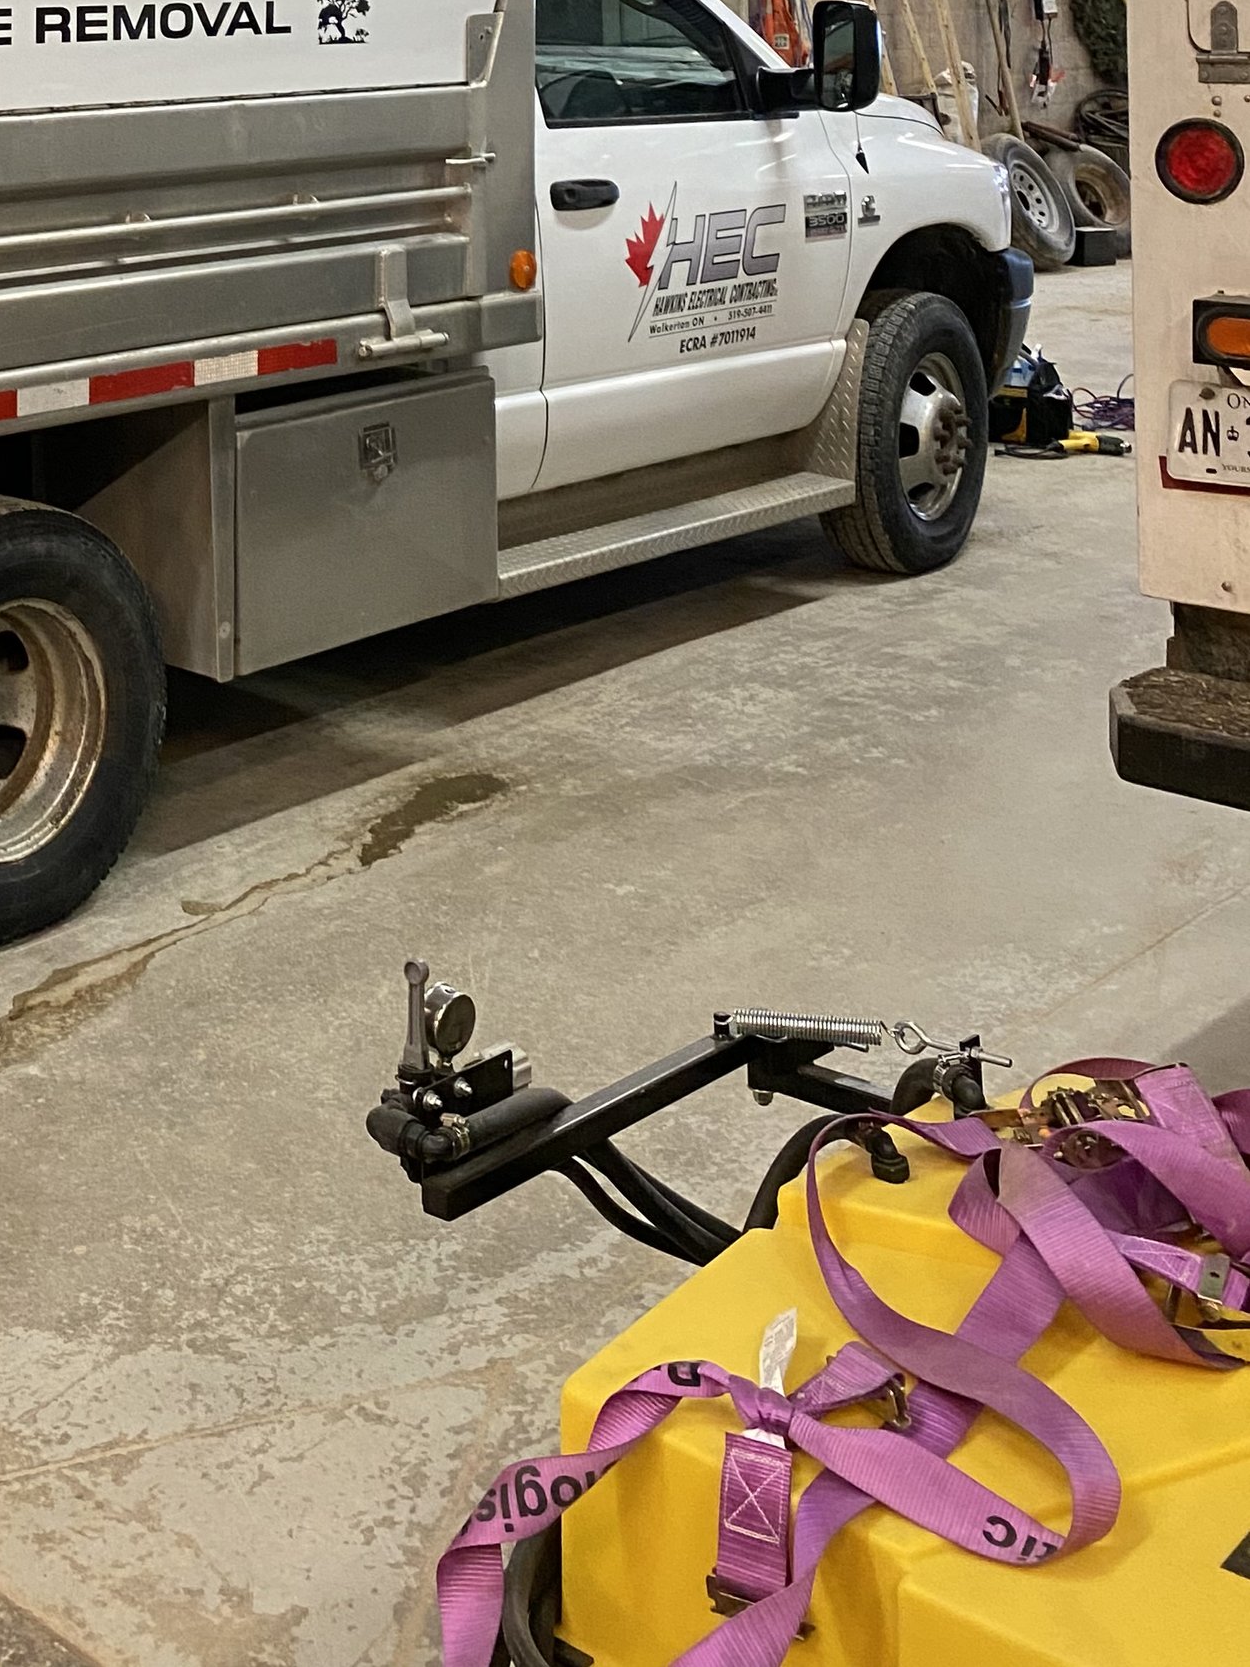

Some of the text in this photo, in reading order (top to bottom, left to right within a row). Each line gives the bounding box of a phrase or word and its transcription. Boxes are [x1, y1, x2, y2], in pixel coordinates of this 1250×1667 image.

[35, 0, 292, 44] REMOVAL
[808, 213, 846, 227] 3500
[658, 203, 787, 291] HEC
[652, 292, 688, 317] HAWKINS
[688, 286, 729, 311] ELECTRICAL
[649, 304, 773, 335] Walkerton ON 519-507-4411
[679, 326, 757, 354] ECRA #7011914
[1178, 407, 1220, 457] AN
